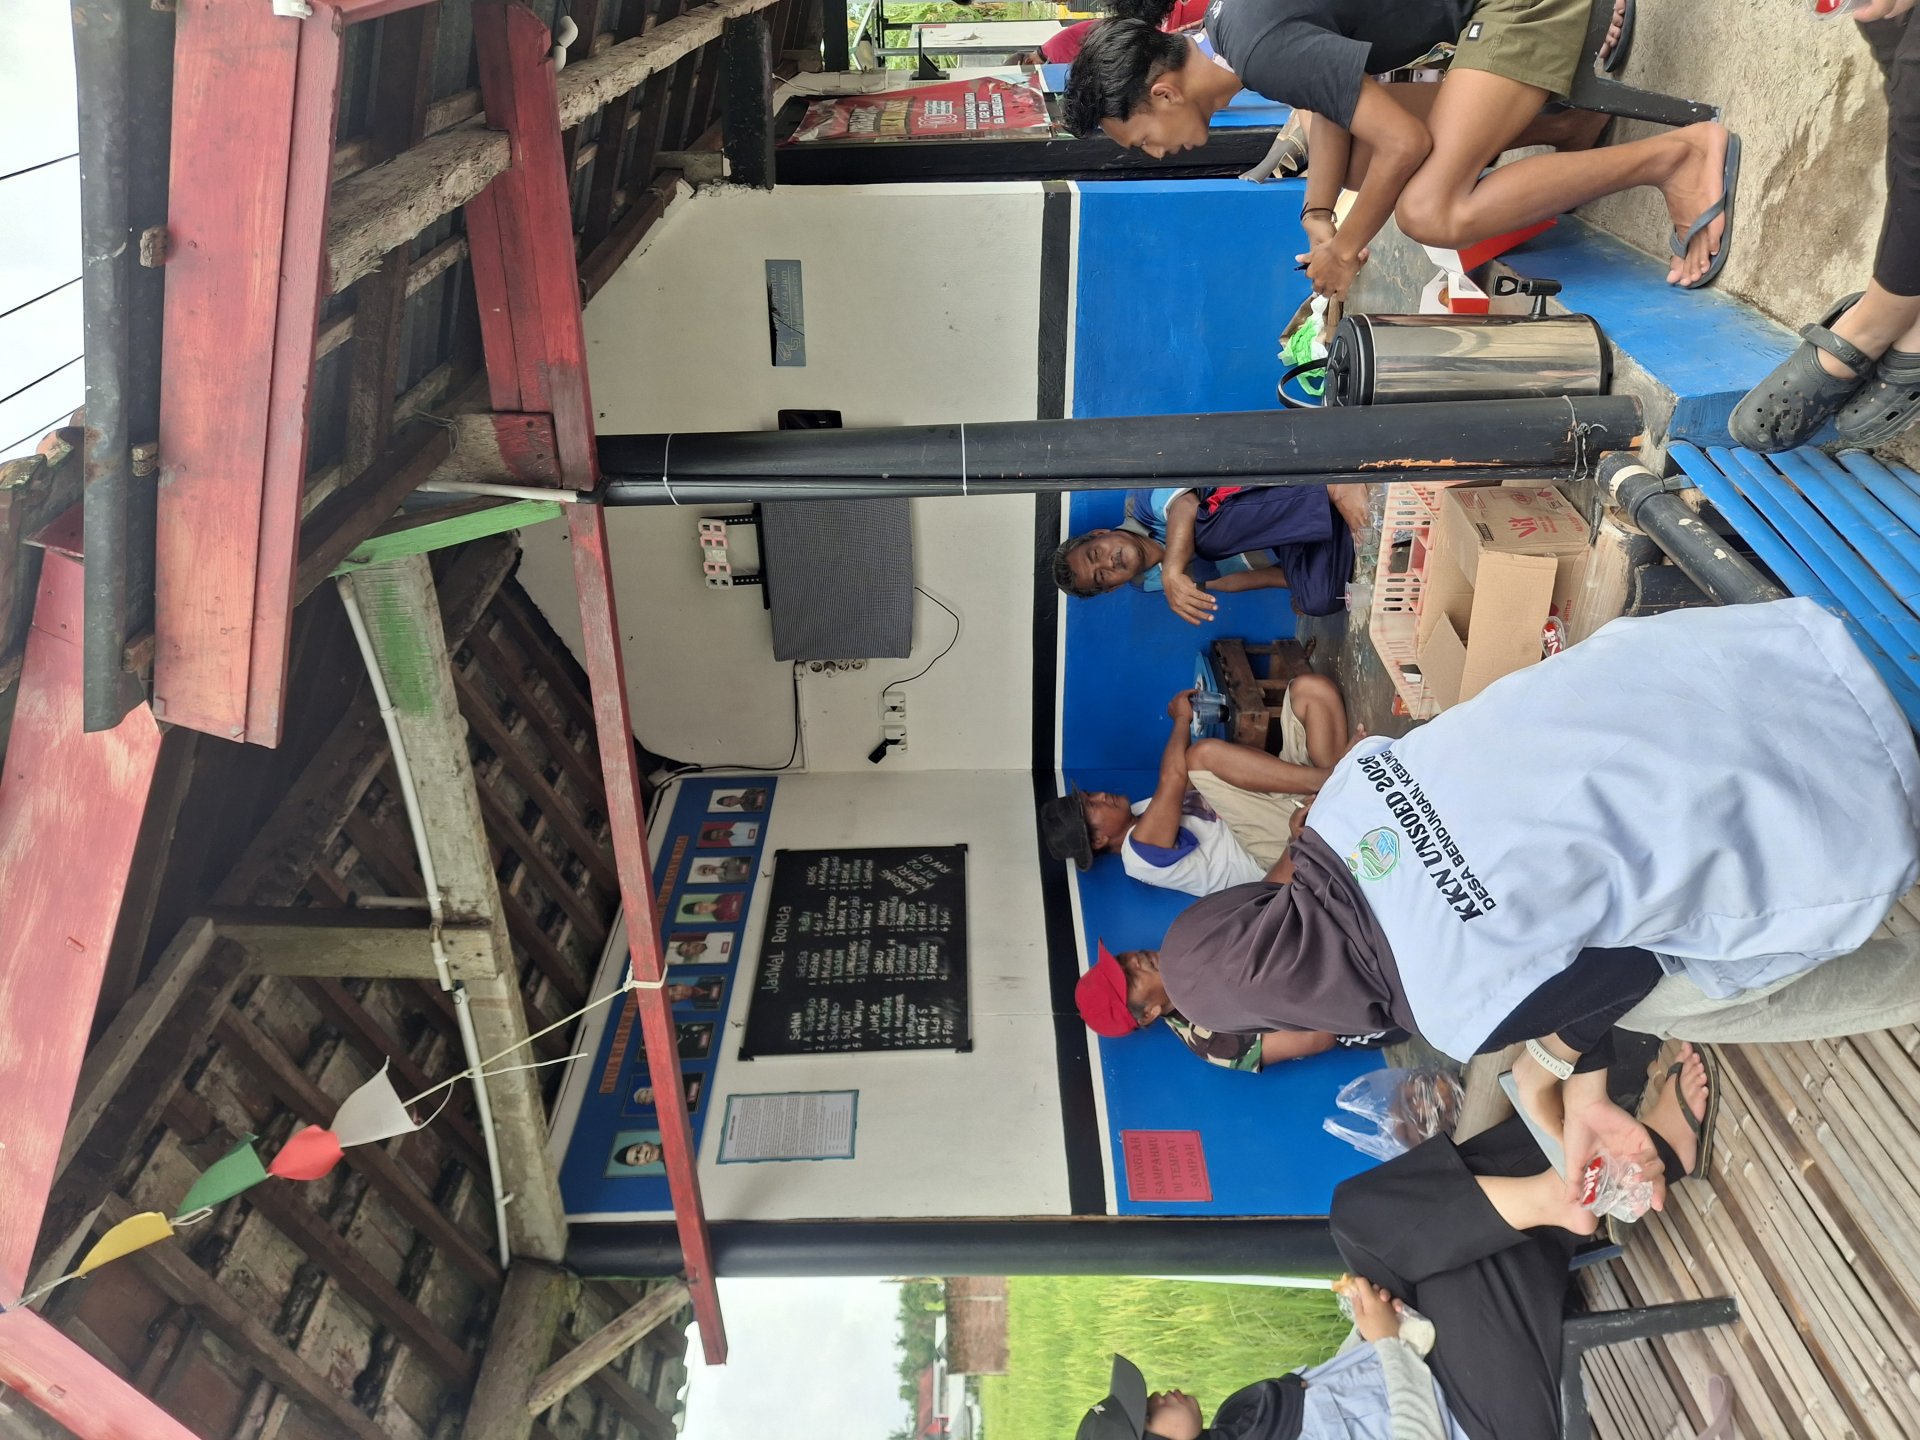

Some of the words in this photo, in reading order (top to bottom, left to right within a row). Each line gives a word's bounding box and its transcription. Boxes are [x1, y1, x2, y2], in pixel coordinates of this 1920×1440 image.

[1508, 517, 1538, 538] Vit
[1357, 755, 1395, 792] 2026
[1385, 791, 1444, 868] UNSOED
[1410, 782, 1465, 868] BENDUNGAN,
[1430, 868, 1484, 922] KKN
[1460, 866, 1496, 910] DESA
[1148, 1136, 1166, 1194] SAMPAHMU
[1166, 1138, 1182, 1180] TEMPAT
[1184, 1144, 1202, 1188] SAMPAH
[1173, 1184, 1184, 1192] DI
